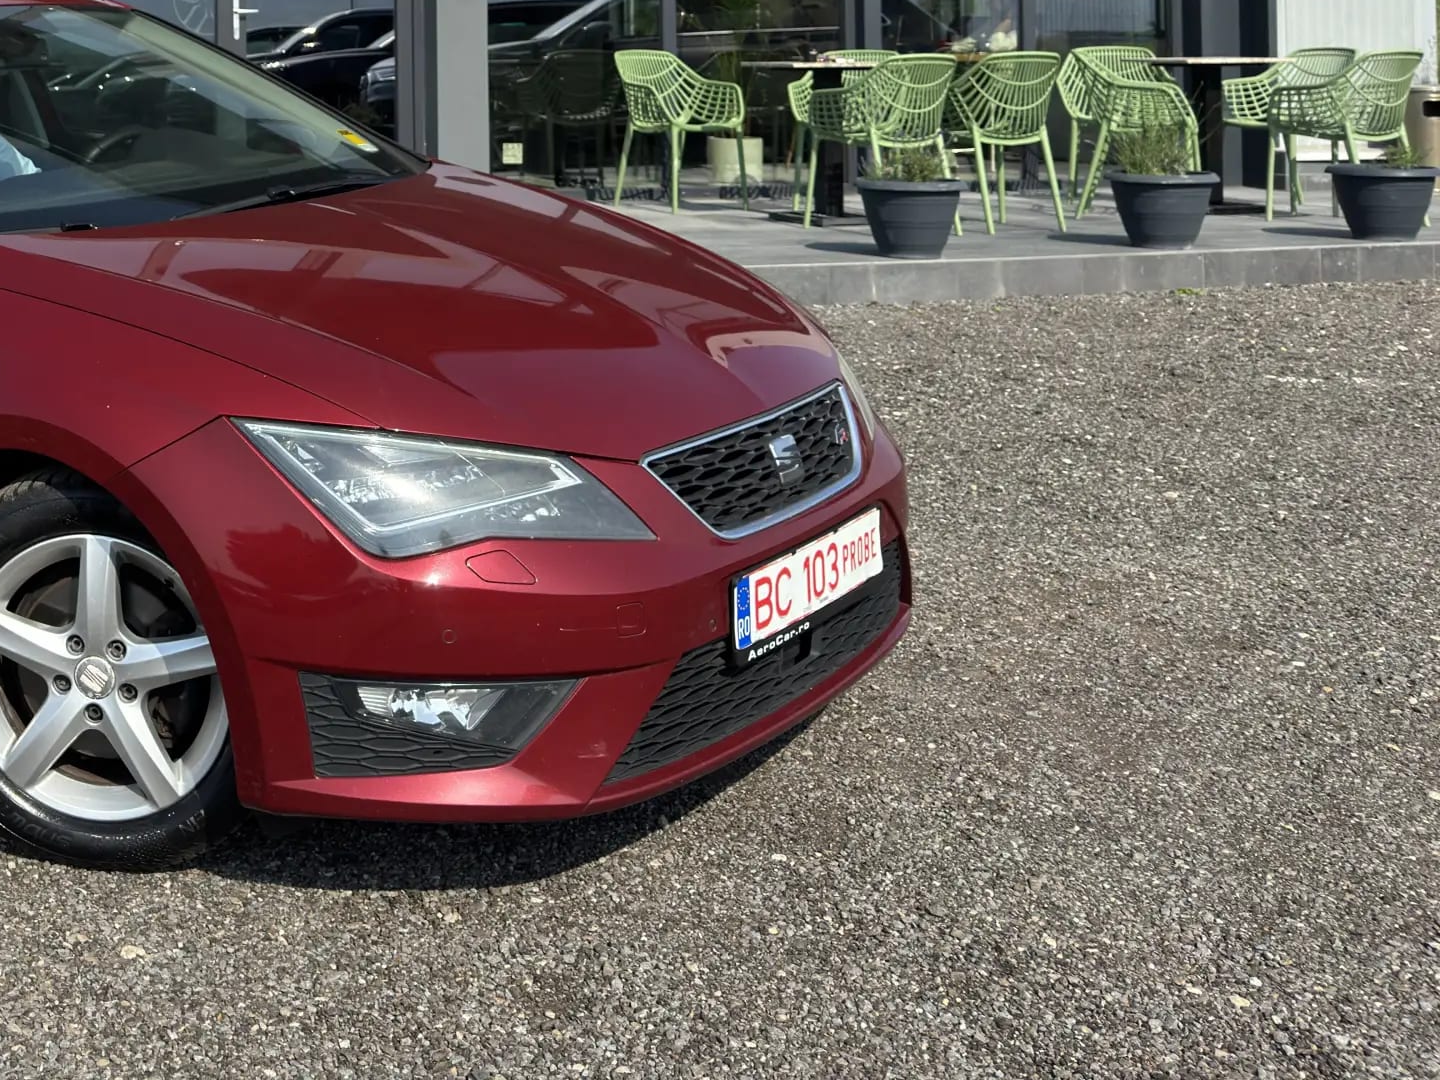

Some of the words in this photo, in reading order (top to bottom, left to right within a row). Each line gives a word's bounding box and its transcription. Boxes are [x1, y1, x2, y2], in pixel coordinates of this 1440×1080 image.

[754, 566, 792, 631] BC
[803, 542, 840, 605] 103
[842, 527, 877, 576] PROBE
[738, 616, 751, 640] RO
[748, 621, 810, 661] AeroCar.ro
